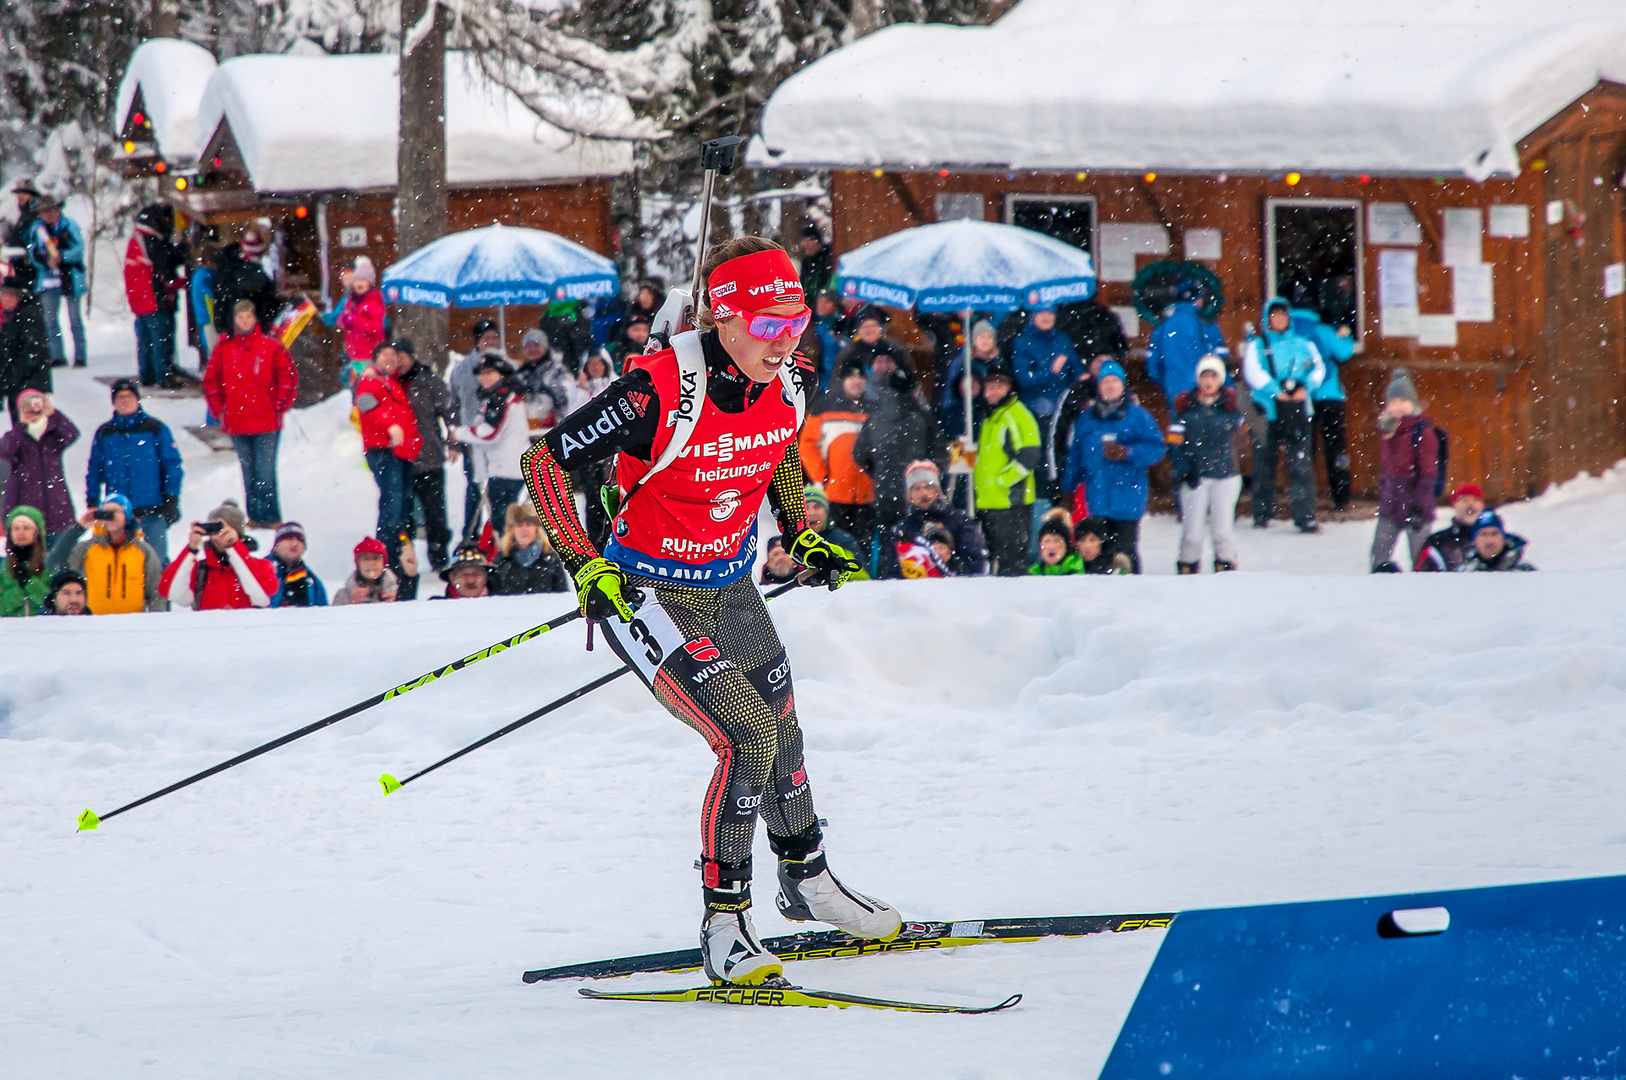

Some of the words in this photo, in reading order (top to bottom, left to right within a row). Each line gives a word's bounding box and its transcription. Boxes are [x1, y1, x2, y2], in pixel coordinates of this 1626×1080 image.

[626, 390, 646, 418] adidas
[678, 373, 698, 422] JOKA
[560, 405, 623, 460] Audi
[678, 427, 795, 463] VIESSMANN
[695, 461, 771, 482] heizung.de
[628, 618, 664, 666] 3
[772, 678, 788, 693] Audi
[708, 898, 751, 911] FISCHER
[1116, 918, 1174, 932] FIS
[774, 940, 942, 962] FISCHER
[695, 989, 785, 1007] FISCHER
